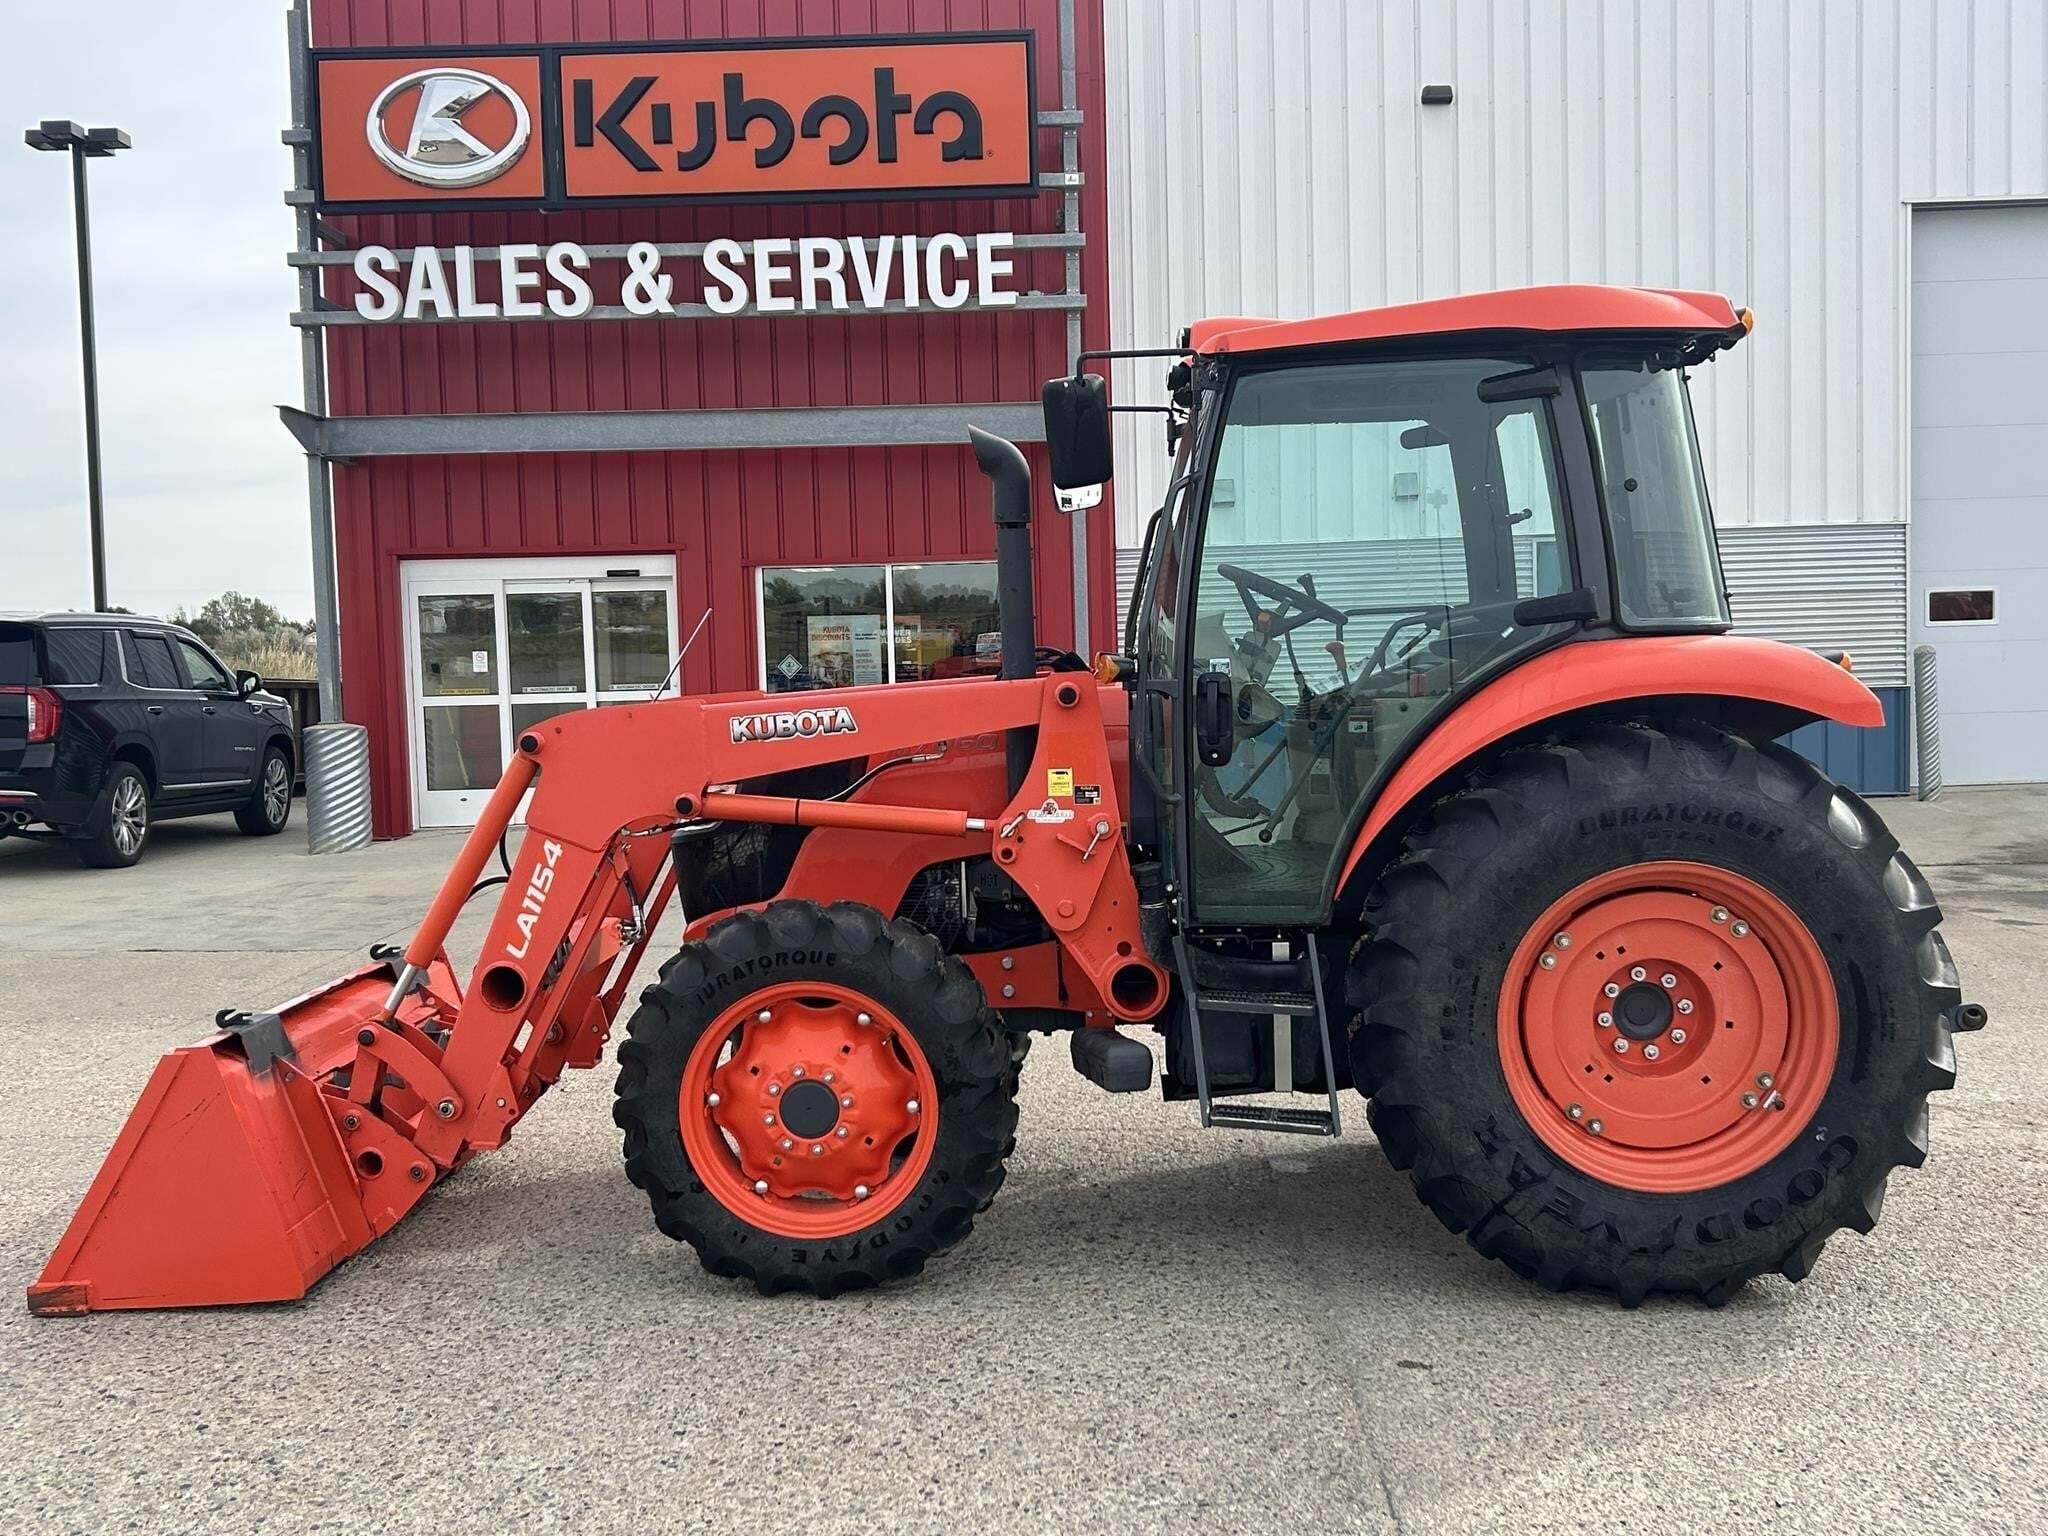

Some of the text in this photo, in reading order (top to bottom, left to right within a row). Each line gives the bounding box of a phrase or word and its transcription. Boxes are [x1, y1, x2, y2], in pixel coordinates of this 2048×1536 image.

[573, 67, 983, 172] Kubota
[354, 232, 1018, 320] SALES & SERVICE
[730, 706, 858, 743] KUBOTA
[1579, 803, 1785, 843] DURATORQUE
[506, 839, 563, 959] LA1154
